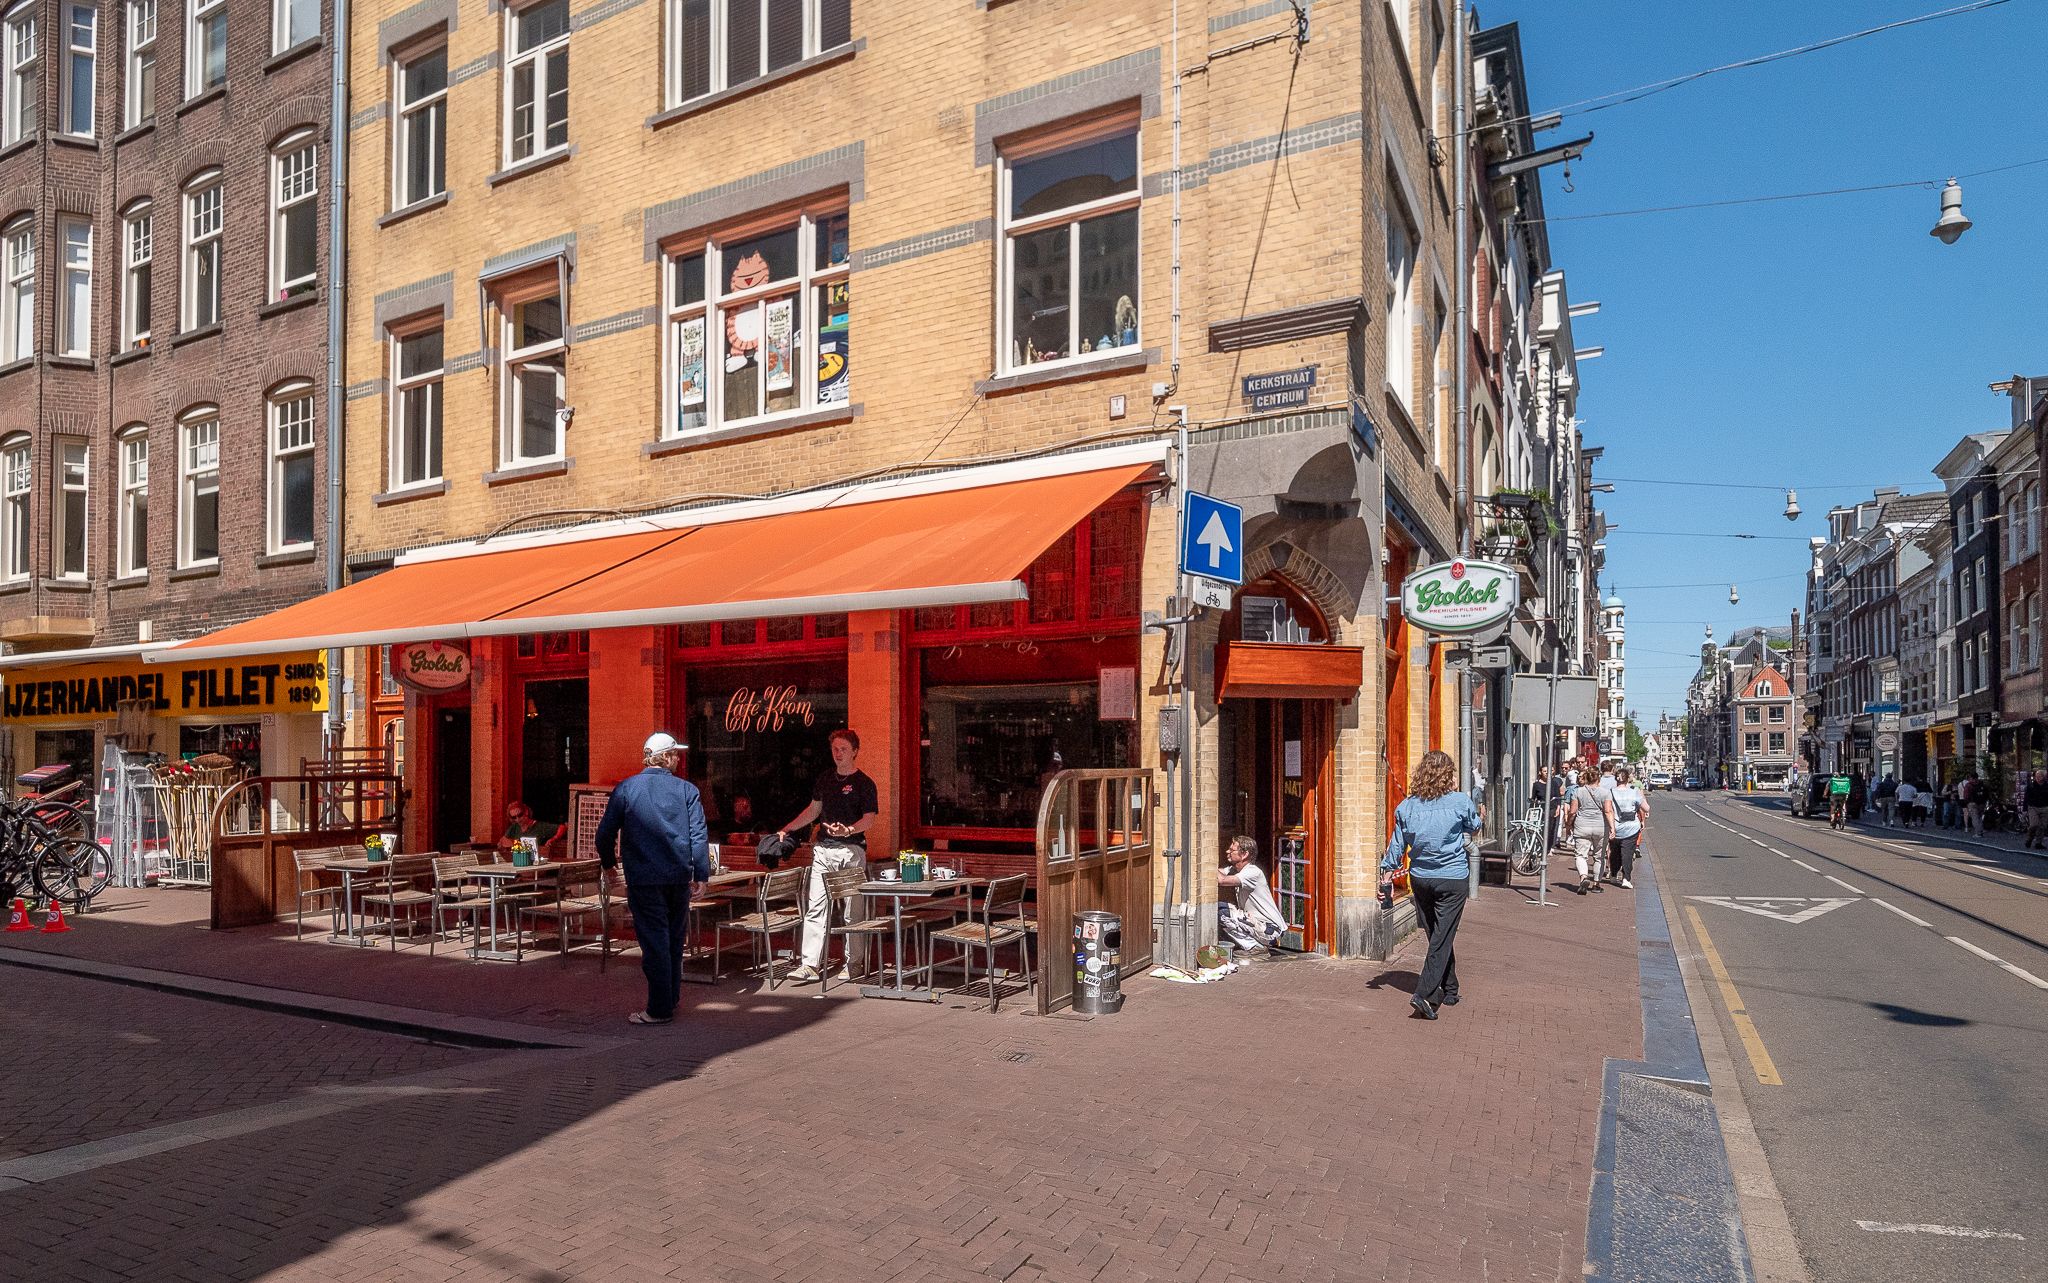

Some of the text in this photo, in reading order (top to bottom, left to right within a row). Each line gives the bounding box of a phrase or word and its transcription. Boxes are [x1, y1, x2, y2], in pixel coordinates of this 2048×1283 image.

[1248, 371, 1311, 391] KERKSTRAAT
[1256, 390, 1304, 407] CENTRUM
[1414, 577, 1502, 613] Grolsch
[285, 662, 326, 681] SINDS
[408, 650, 464, 673] Grolsch
[4, 664, 280, 718] IJZERHANDEL FILLET
[287, 685, 322, 705] 1890
[725, 684, 815, 733] Café Krom
